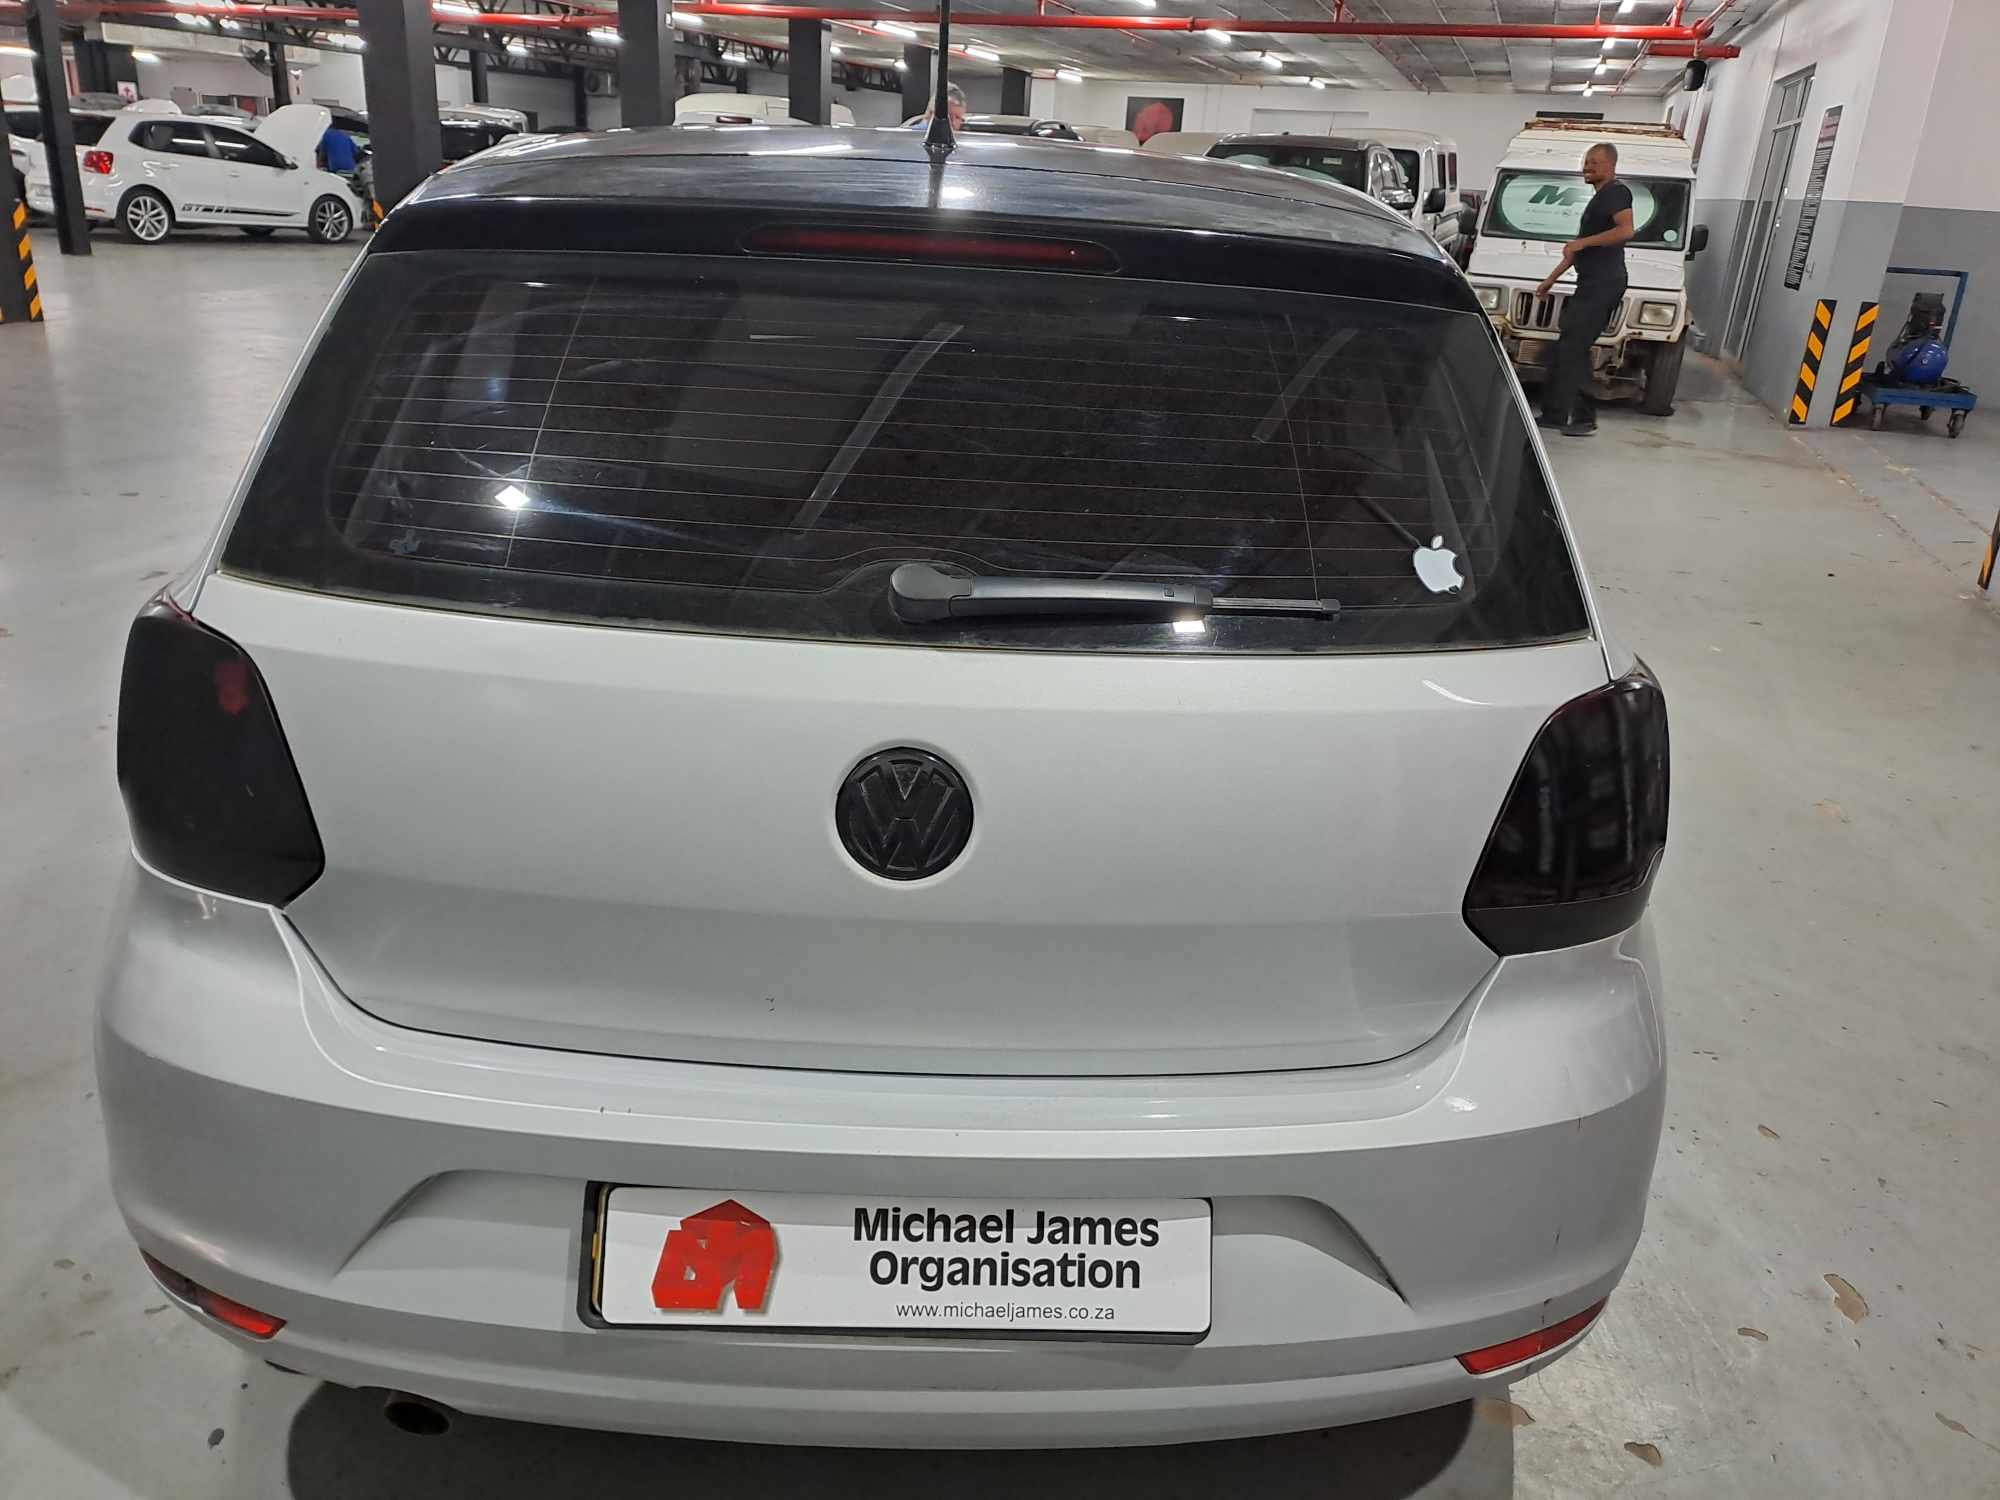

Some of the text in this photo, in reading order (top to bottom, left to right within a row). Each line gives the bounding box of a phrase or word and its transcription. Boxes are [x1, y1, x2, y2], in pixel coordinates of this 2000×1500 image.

[854, 1206, 1160, 1247] Michael James
[869, 1250, 1140, 1292] Organisation
[896, 1301, 1115, 1323] www.michaeljames.co.za
